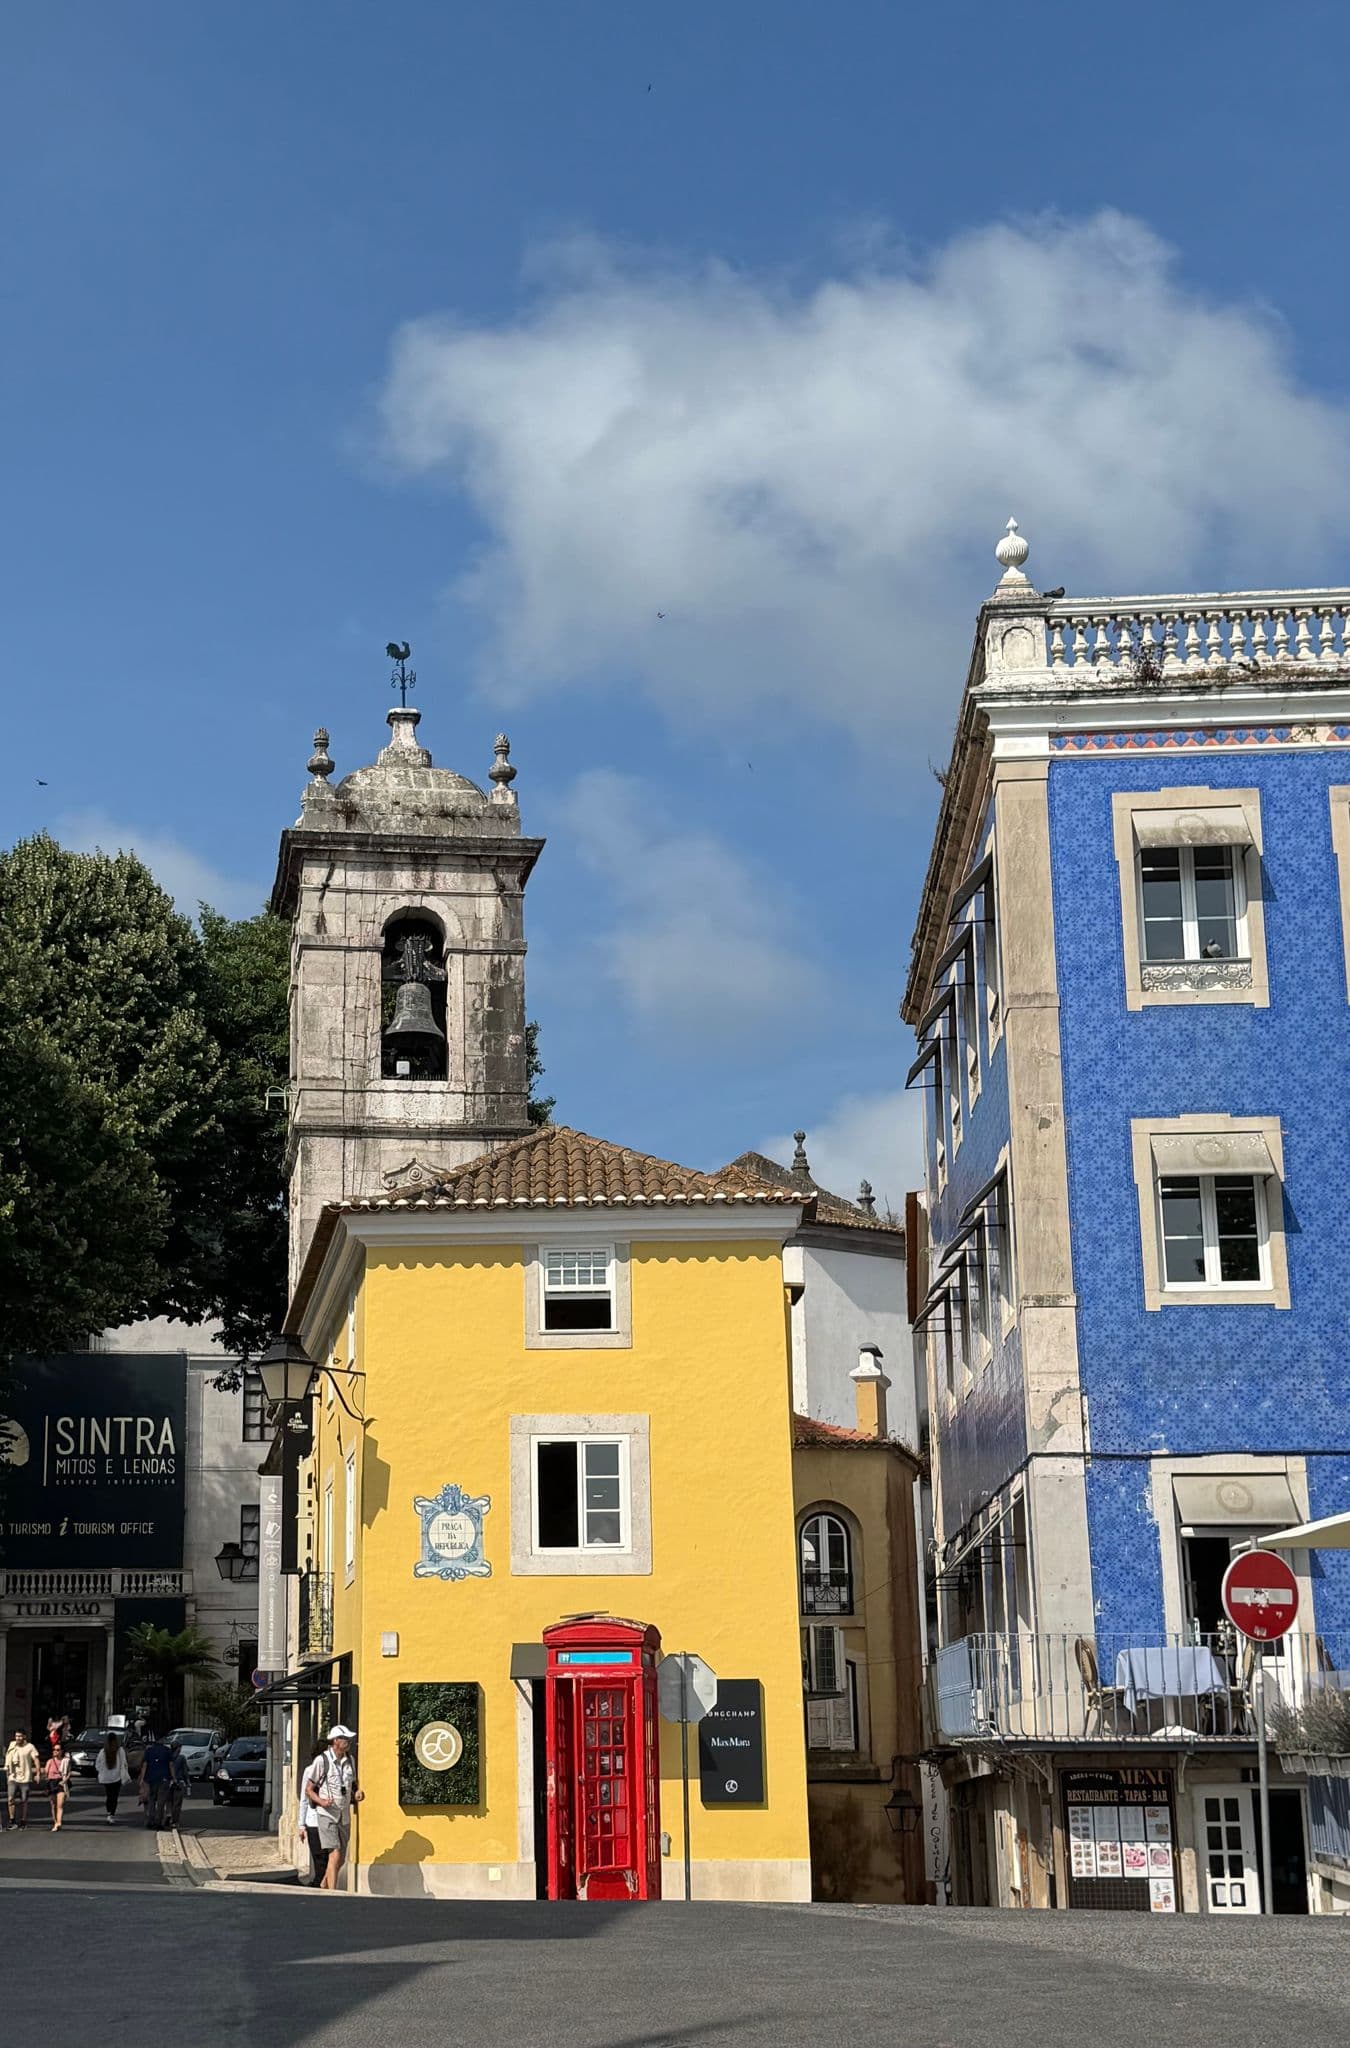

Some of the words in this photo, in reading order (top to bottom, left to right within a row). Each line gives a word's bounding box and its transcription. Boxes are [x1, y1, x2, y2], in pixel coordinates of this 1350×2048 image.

[55, 1416, 176, 1455] SINTRA
[55, 1458, 96, 1475] MITOS
[105, 1458, 114, 1475] E
[123, 1458, 176, 1475] LENDAS
[8, 1522, 52, 1535] TURISMO
[73, 1522, 115, 1535] TOURISM
[120, 1522, 155, 1535] OFFICE
[14, 1602, 101, 1616] TURISMO
[1120, 1769, 1168, 1785] MENU
[1067, 1790, 1119, 1802] RESTAURANTE
[1124, 1791, 1148, 1802] TAPAS
[1153, 1790, 1169, 1802] BAR
